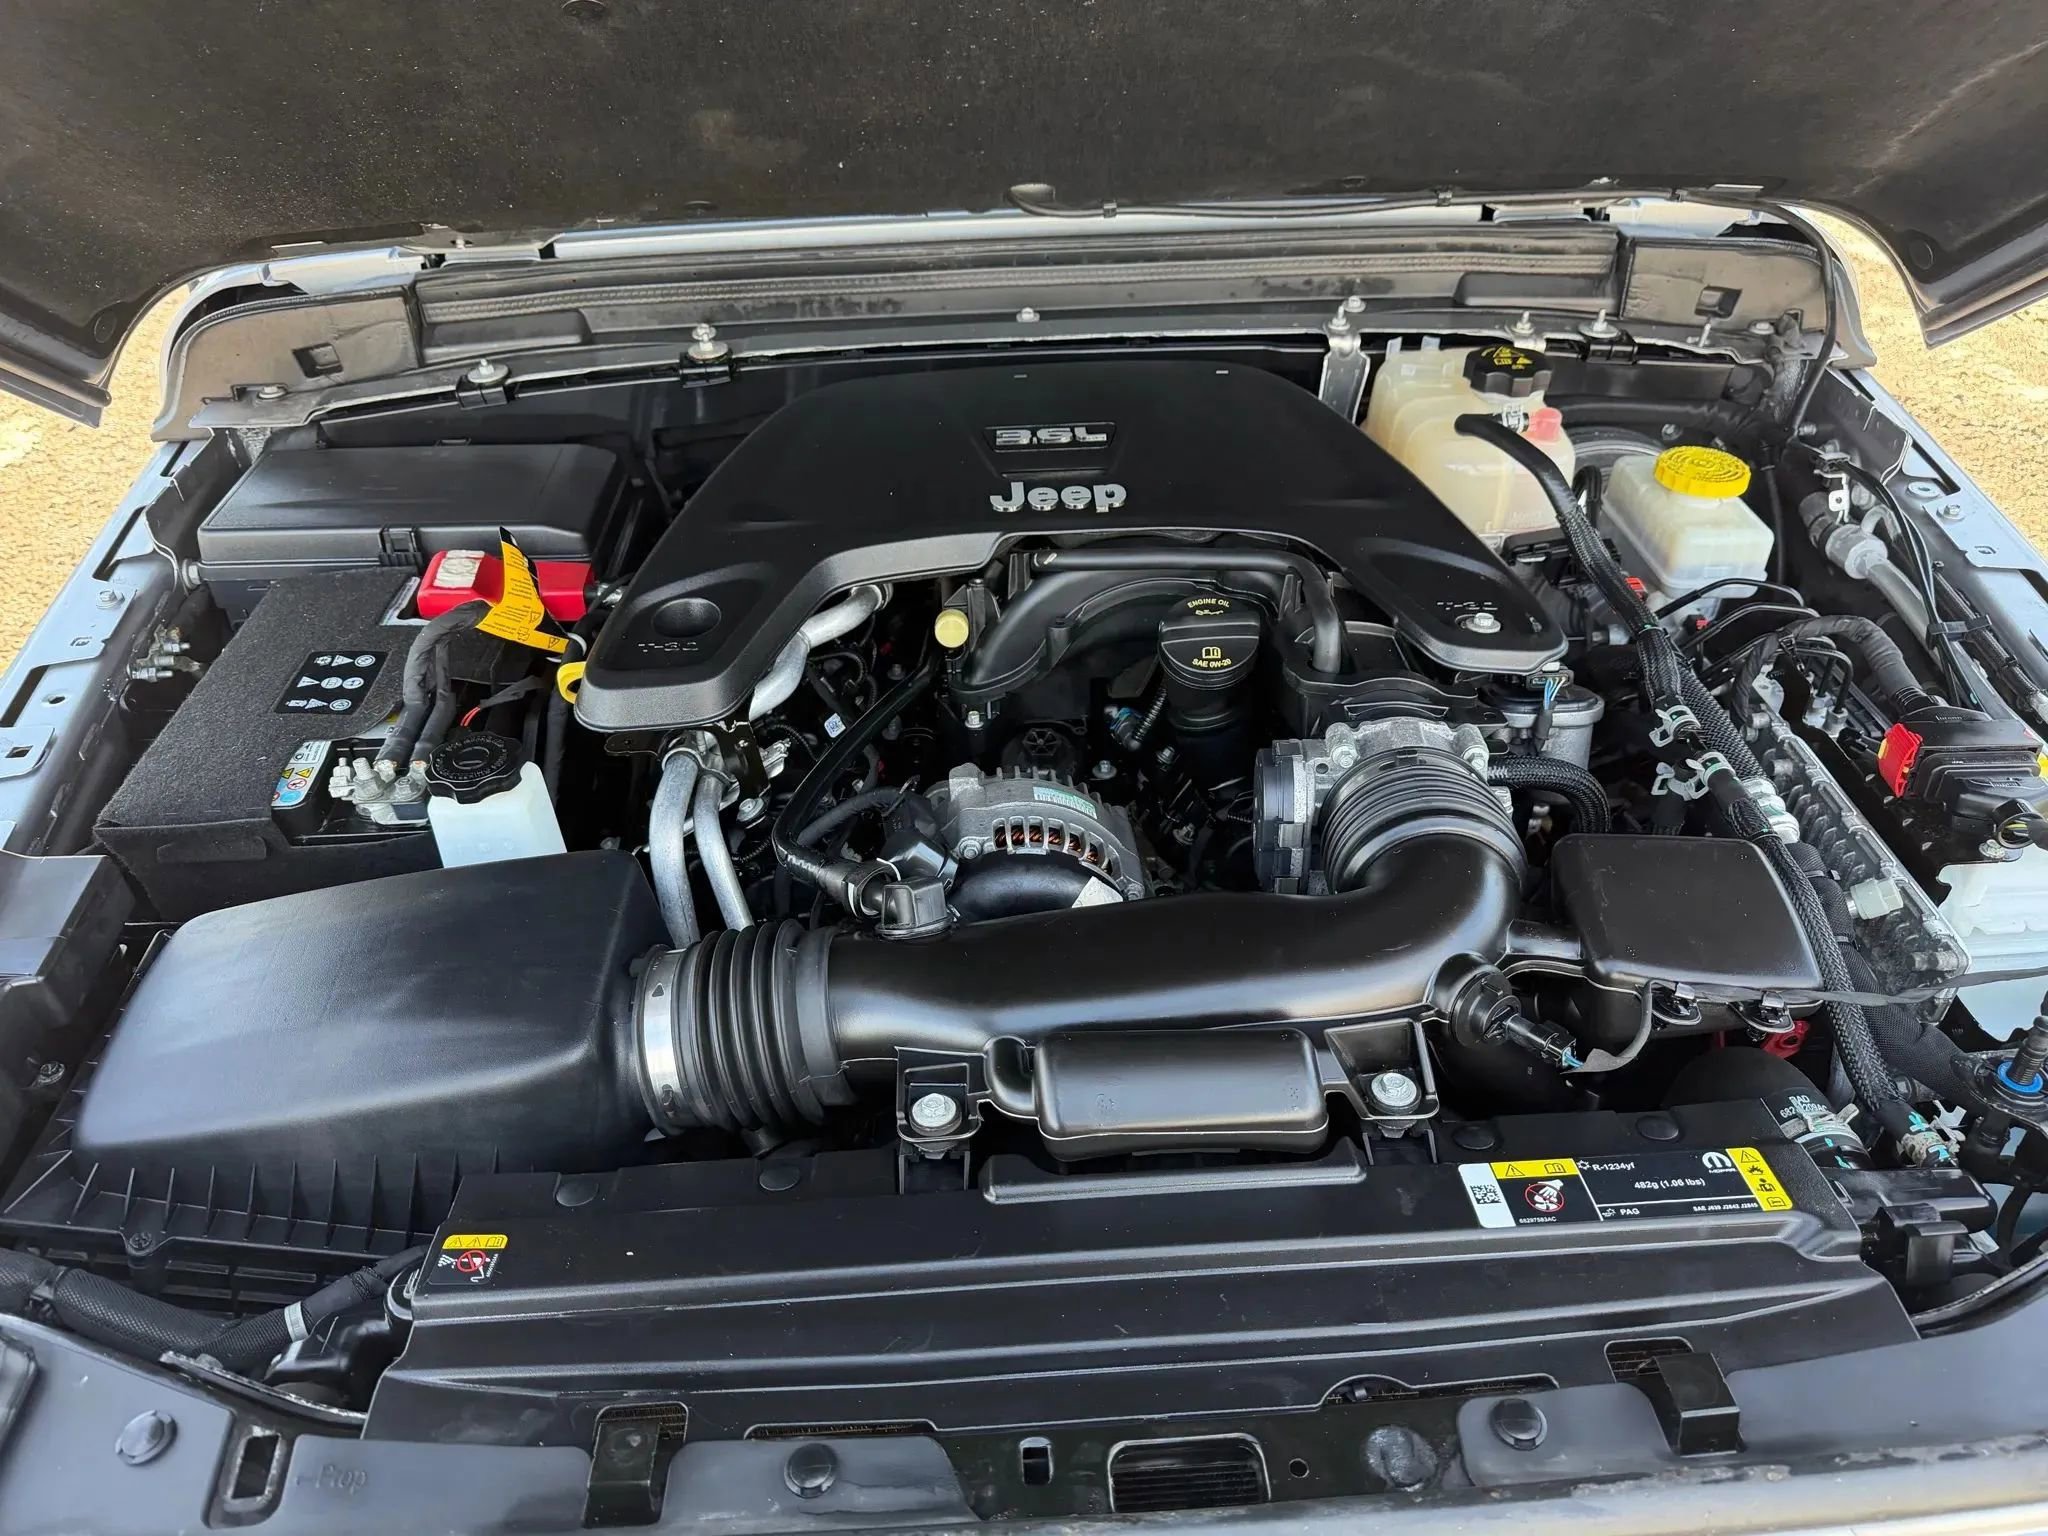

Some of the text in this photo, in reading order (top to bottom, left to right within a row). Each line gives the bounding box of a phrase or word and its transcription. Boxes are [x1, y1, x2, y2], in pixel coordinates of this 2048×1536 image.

[989, 481, 1127, 513] Jeep
[1187, 598, 1230, 608] ENGINE OIL
[1192, 658, 1232, 668] SAE 0W-20
[1591, 1161, 1636, 1172] R-1234yf
[1634, 1177, 1706, 1190] 482g (1.06 lbs)
[1619, 1207, 1640, 1215] PAG
